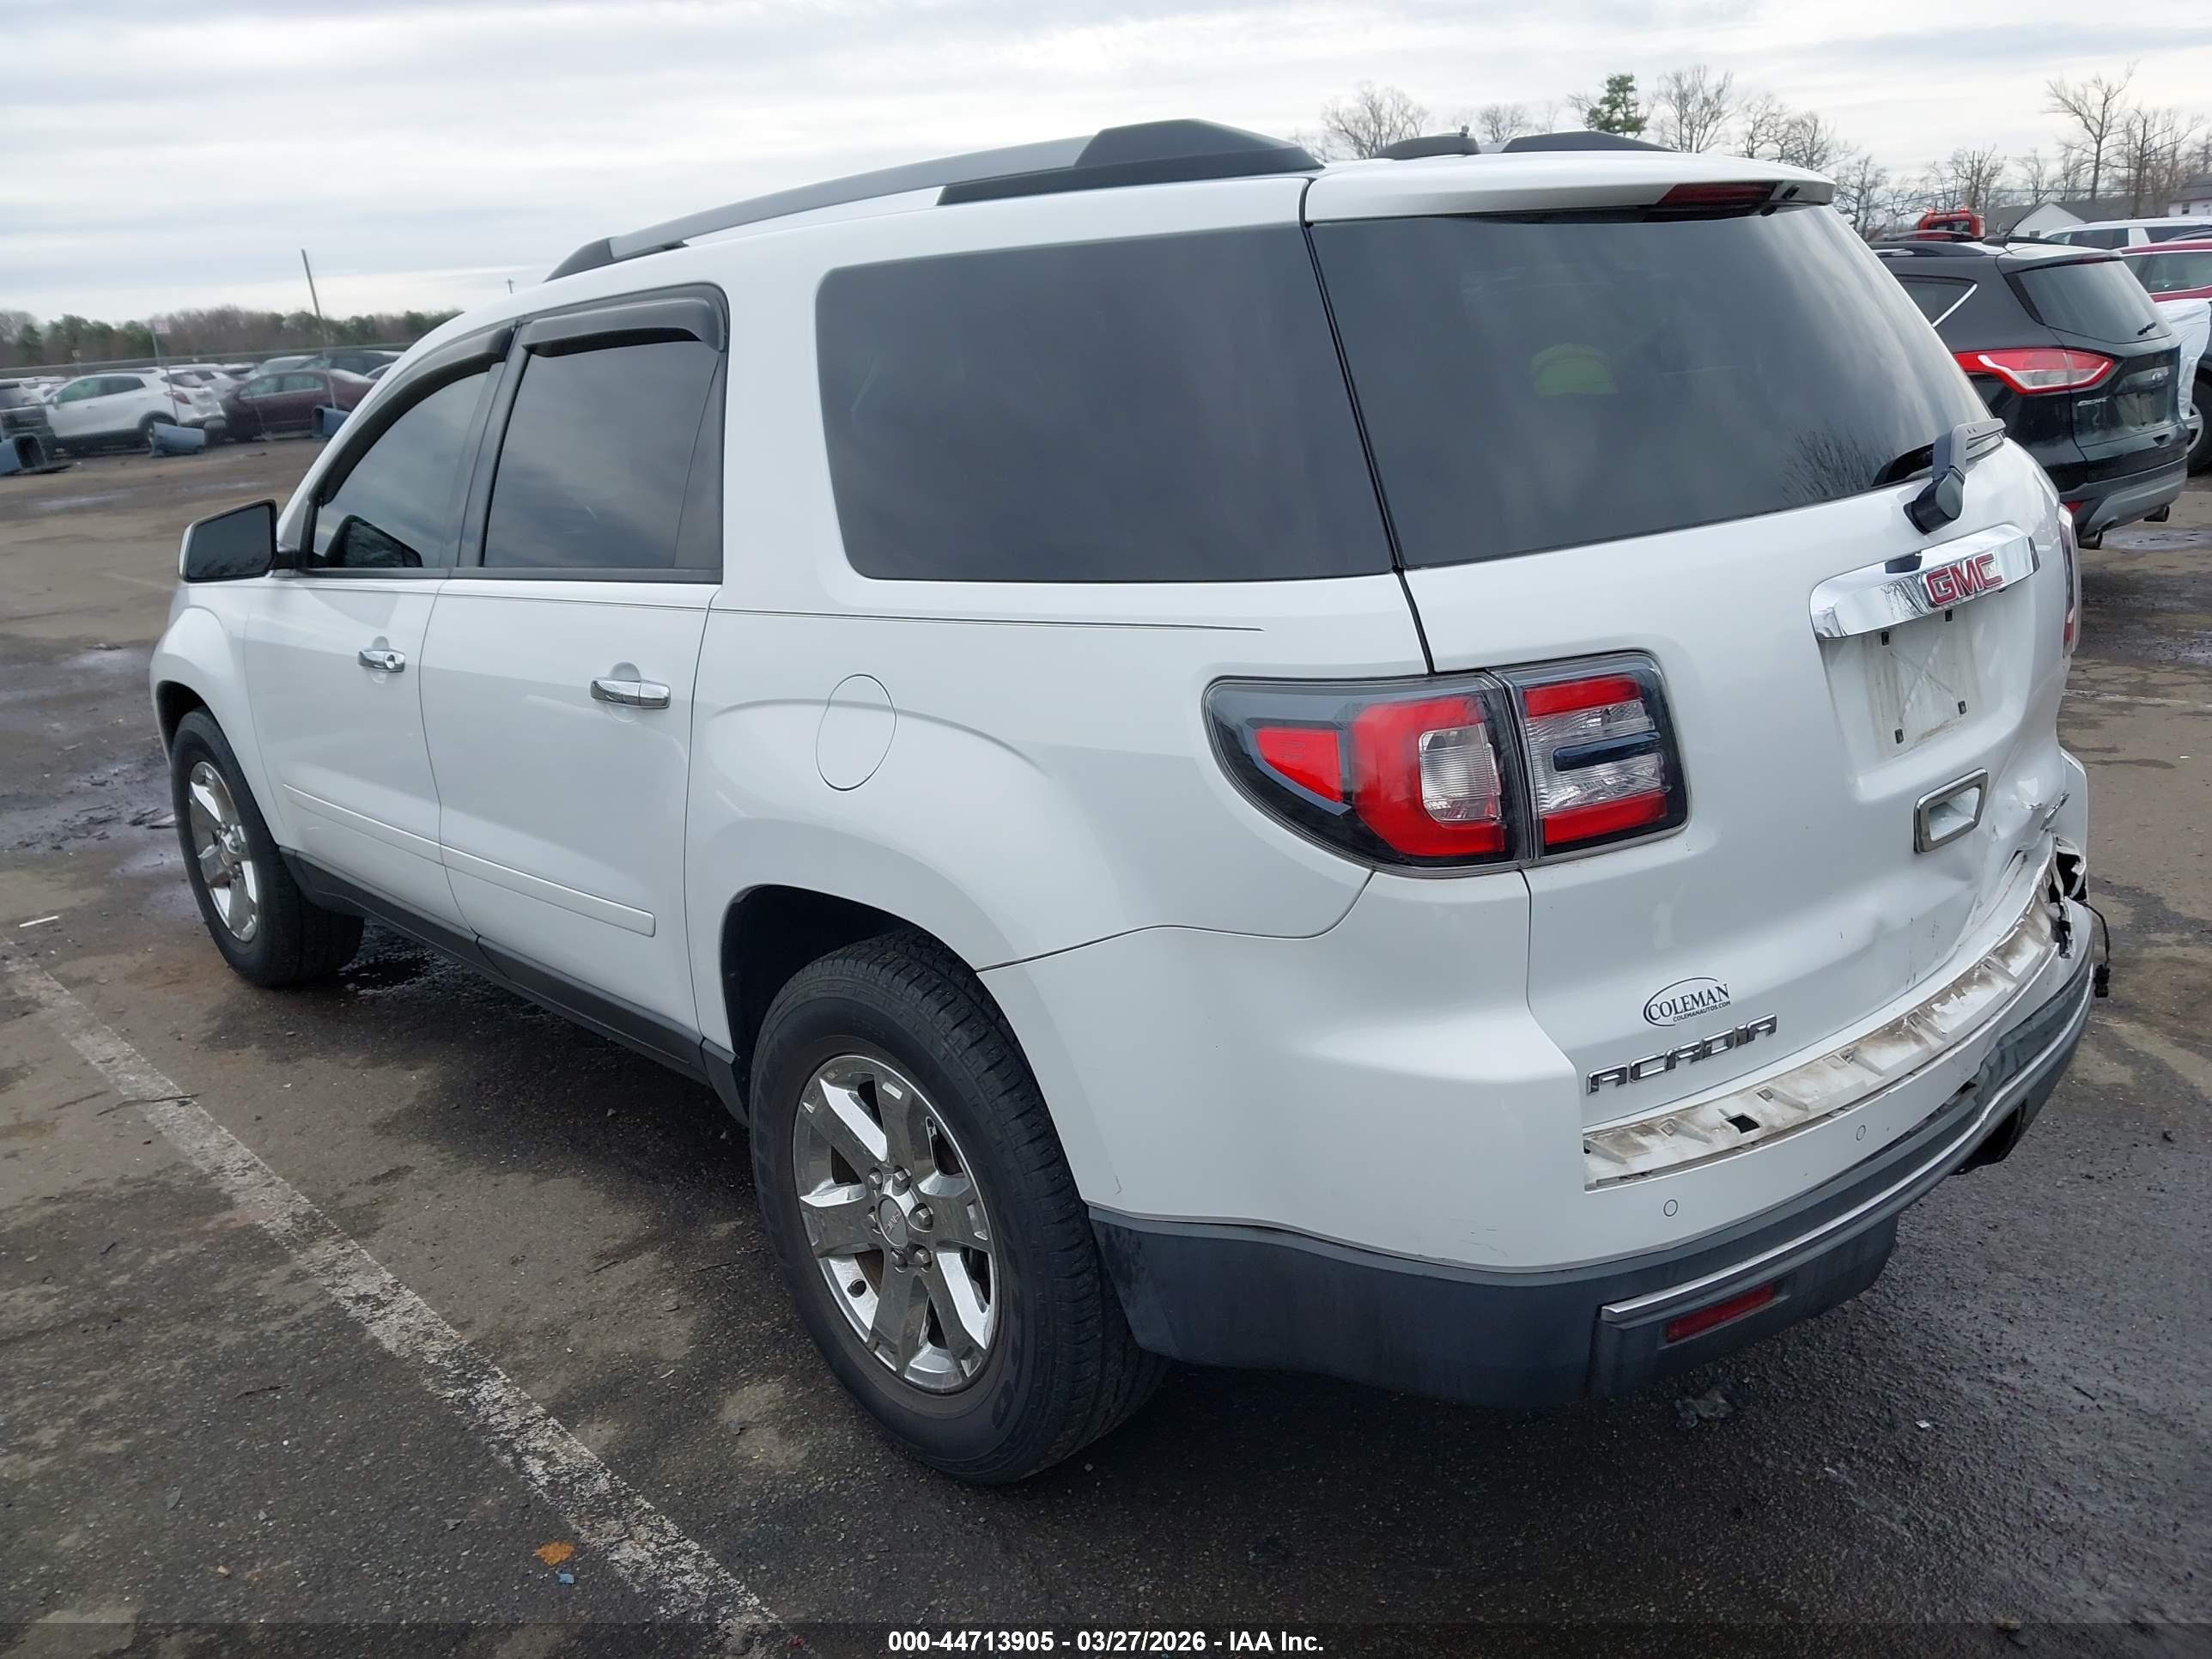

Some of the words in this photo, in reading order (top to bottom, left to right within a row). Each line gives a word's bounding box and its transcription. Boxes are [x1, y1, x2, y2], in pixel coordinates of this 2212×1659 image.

[1925, 553, 2003, 605] GMC
[1647, 983, 1731, 1022] COLEMAN
[1672, 1000, 1731, 1023] COLEMANAUTOS.COM
[1587, 1012, 1778, 1096] ACADIA
